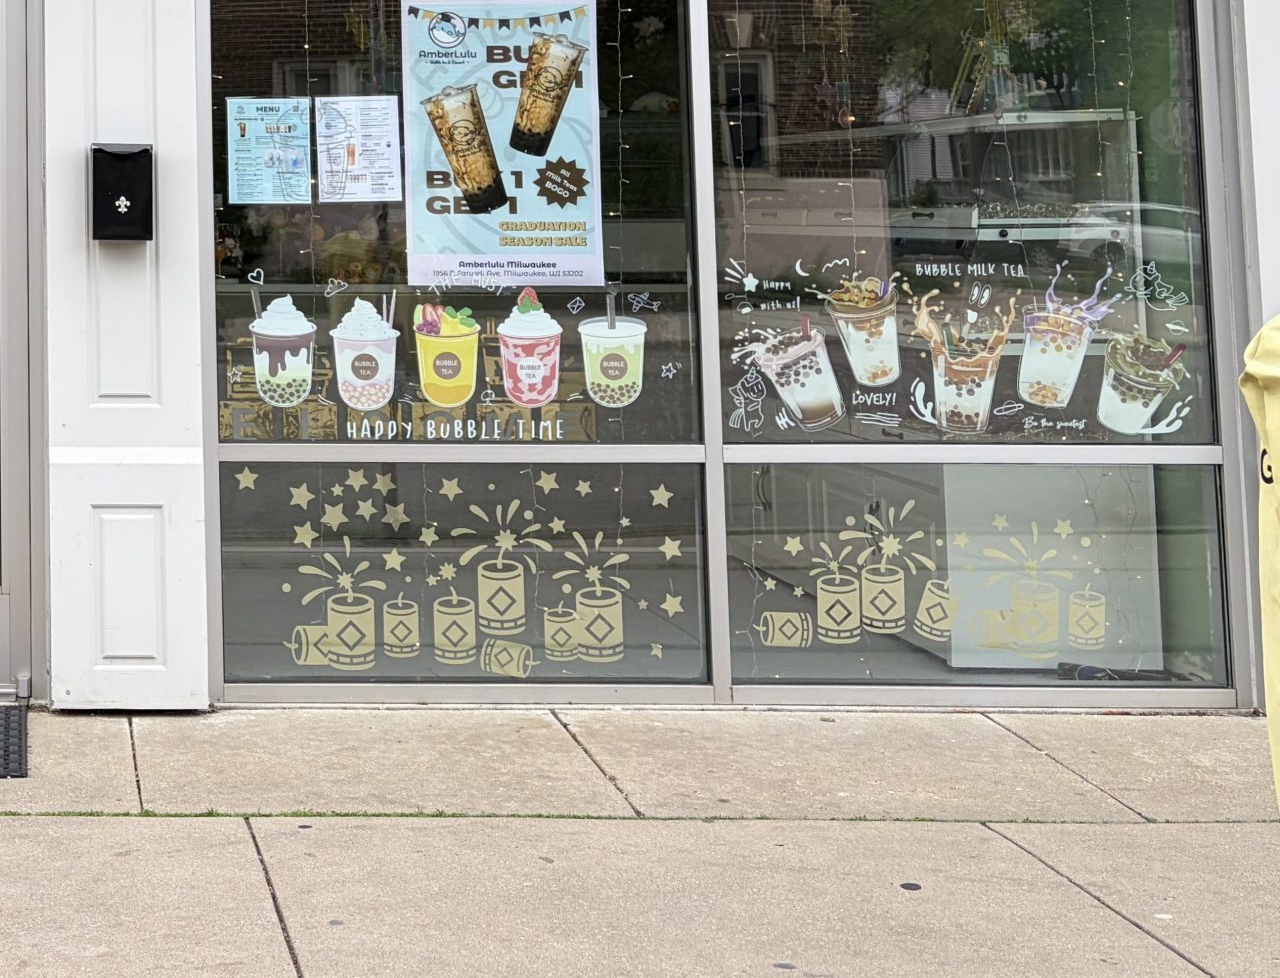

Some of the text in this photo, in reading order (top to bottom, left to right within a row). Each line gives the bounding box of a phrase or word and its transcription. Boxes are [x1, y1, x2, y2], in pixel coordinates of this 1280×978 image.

[418, 50, 477, 58] AmberLulu
[486, 45, 533, 63] BU
[560, 168, 570, 178] All
[545, 181, 570, 198] BOGO
[562, 178, 578, 192] Teas
[498, 221, 587, 232] GRADUATION
[498, 236, 587, 247] SEASON SALE
[458, 260, 557, 269] Amberlulu Milwaukee
[915, 263, 1025, 277] BUBBLE MILK TEA
[503, 270, 548, 278] Milwaukee,
[763, 279, 792, 291] Happy
[852, 392, 897, 406] LOVELY!
[347, 419, 564, 440] HAPPY BUBBLE TIME
